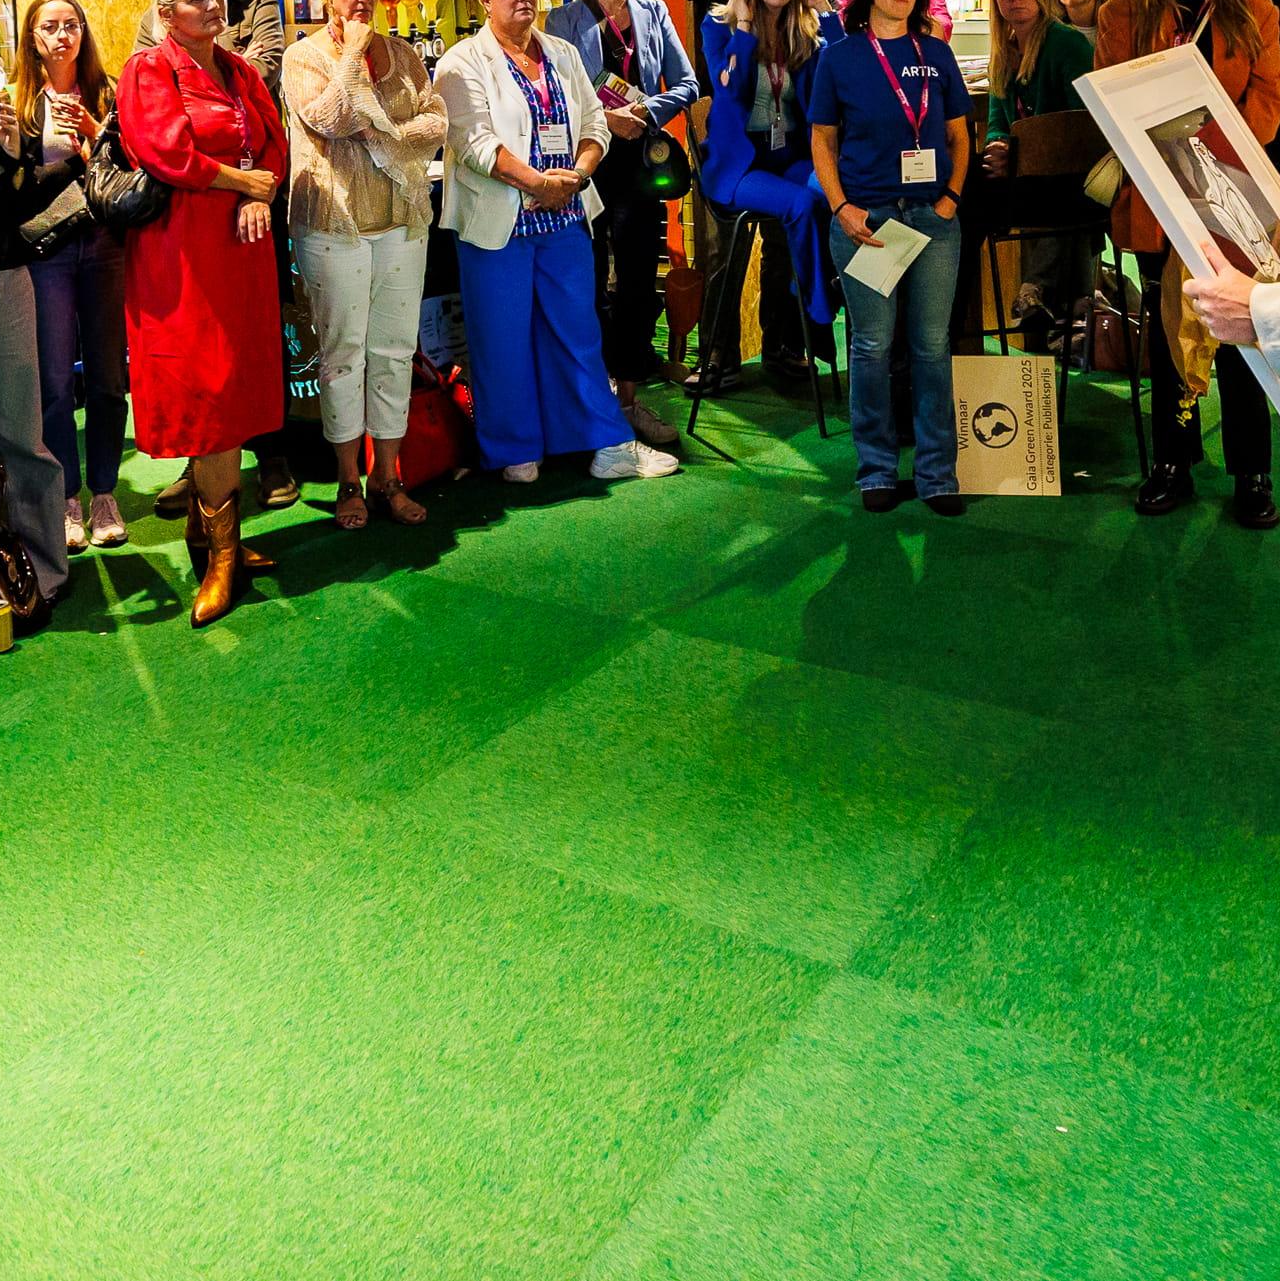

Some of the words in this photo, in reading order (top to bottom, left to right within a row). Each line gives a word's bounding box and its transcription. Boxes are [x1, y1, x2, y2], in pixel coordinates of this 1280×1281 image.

[901, 66, 939, 78] ARTIS
[1021, 359, 1033, 388] 2025
[1024, 390, 1034, 427] Award
[1041, 367, 1055, 430] Publieksprijs
[958, 398, 971, 451] Winnaar
[1025, 428, 1036, 465] Green
[1045, 431, 1057, 484] Categorie:
[1026, 465, 1038, 491] Gaia
